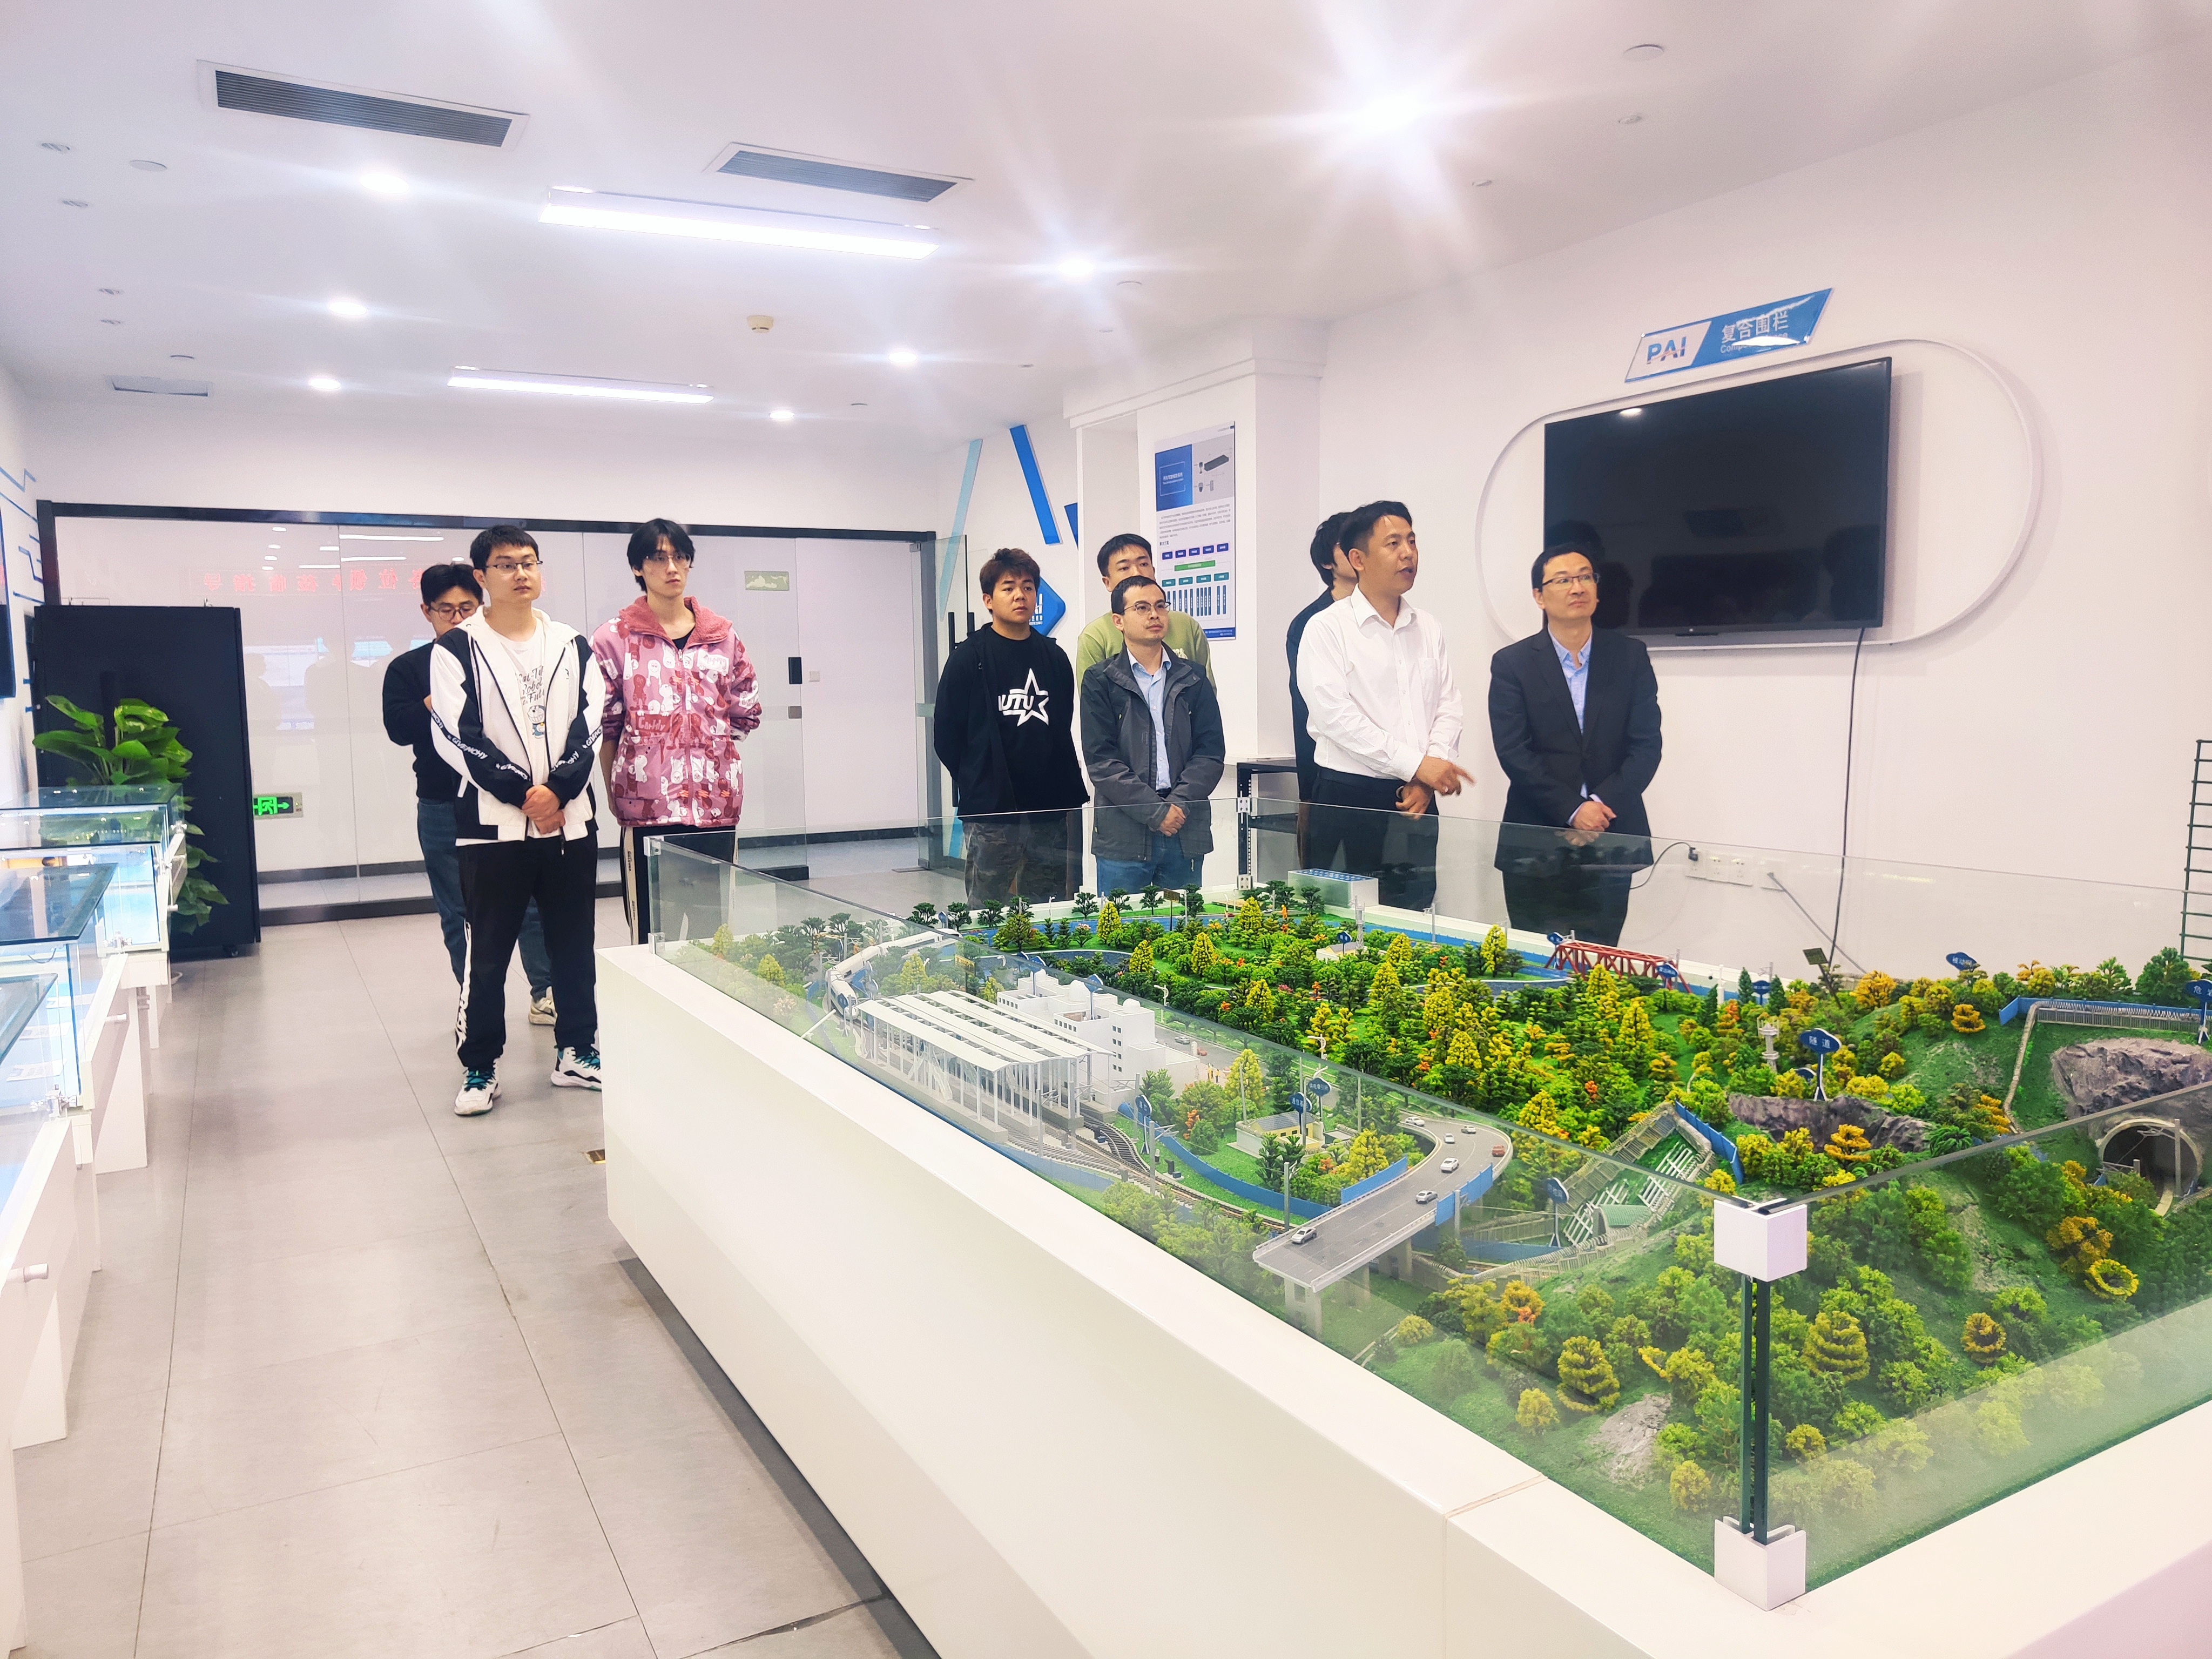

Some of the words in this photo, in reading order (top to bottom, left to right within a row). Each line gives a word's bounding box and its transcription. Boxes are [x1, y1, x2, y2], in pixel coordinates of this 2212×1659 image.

[1722, 311, 1789, 343] 复合围栏
[1647, 336, 1687, 365] PAI
[451, 737, 488, 759] GIVENCHY
[1809, 1035, 1830, 1049] 隧道
